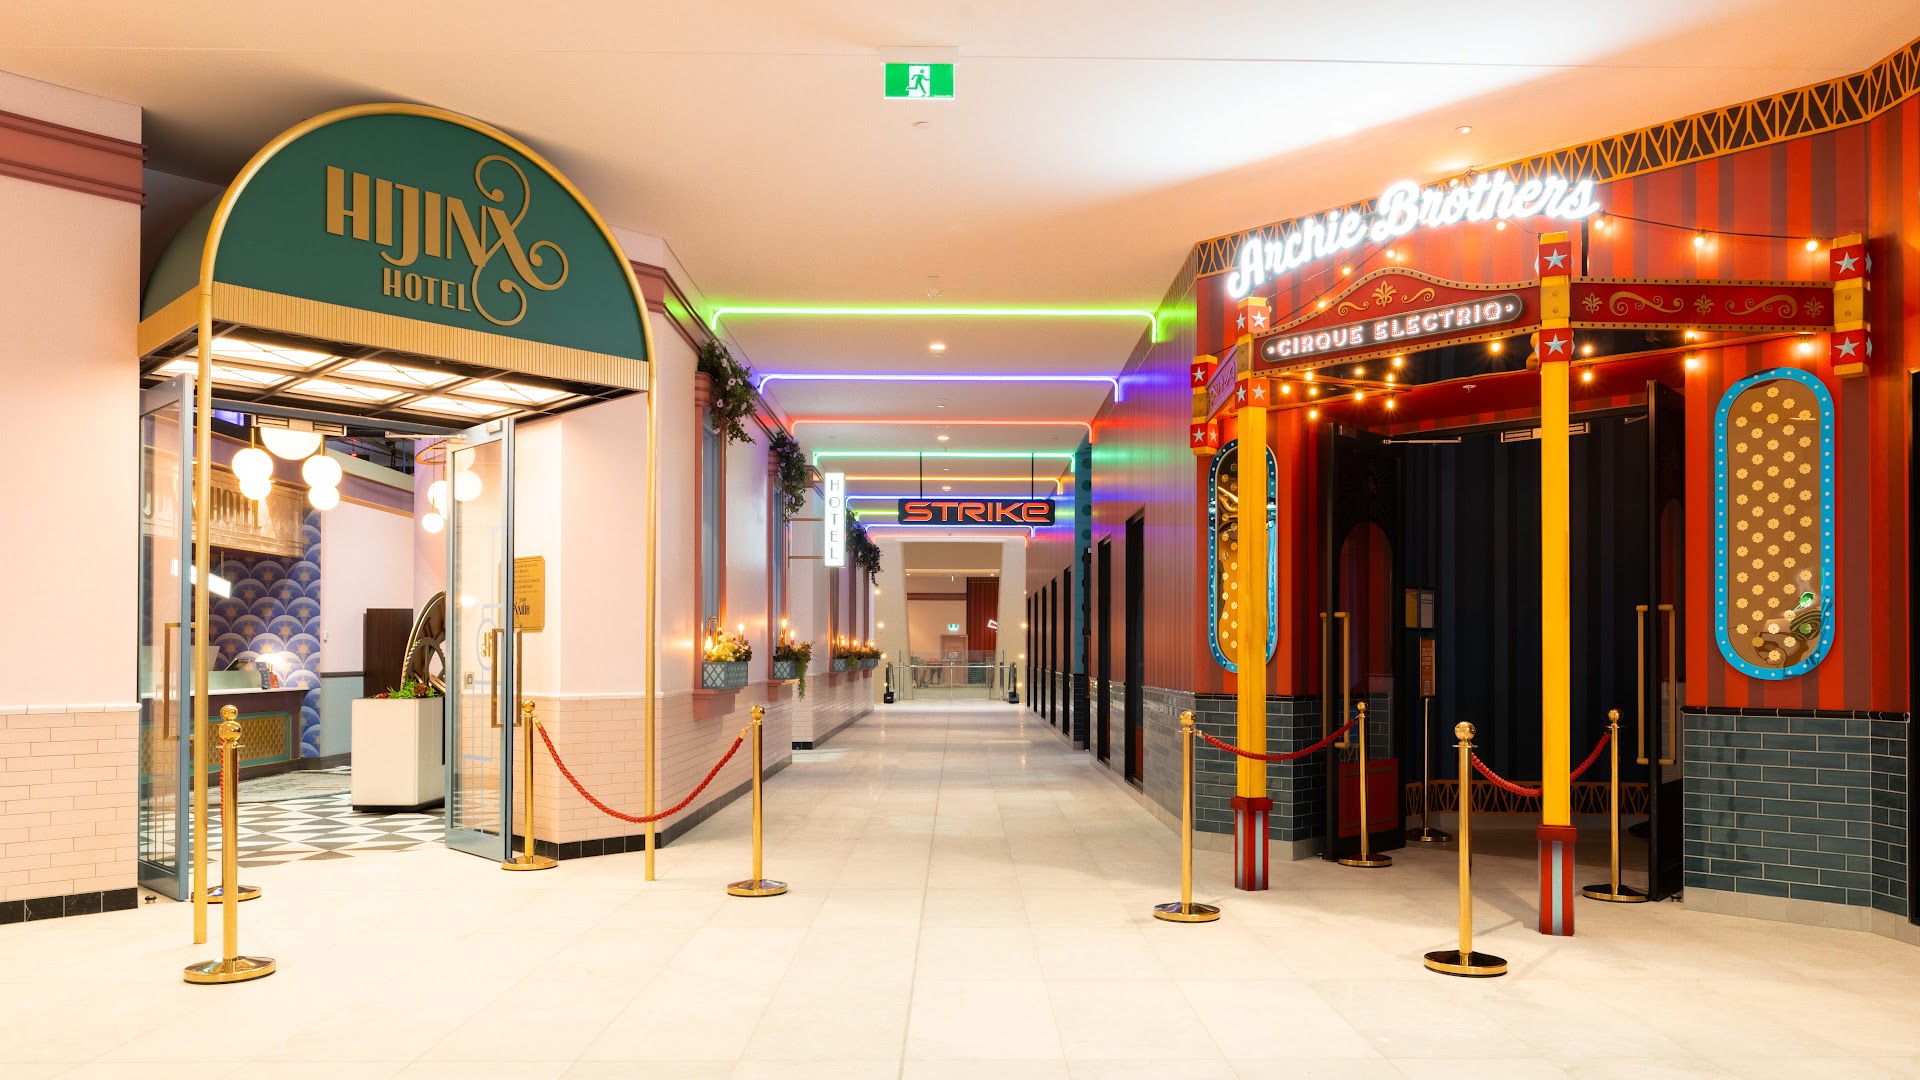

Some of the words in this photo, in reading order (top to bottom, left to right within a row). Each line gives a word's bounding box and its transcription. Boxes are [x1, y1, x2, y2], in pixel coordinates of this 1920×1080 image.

[326, 155, 569, 326] HIJINX
[1227, 210, 1367, 299] Archie
[1370, 171, 1602, 243] Brothers
[383, 267, 472, 312] HOTEL
[1275, 325, 1363, 357] CIRQUE
[1373, 301, 1501, 341] ELECTRIQ
[828, 479, 841, 560] HOTEL
[902, 501, 1051, 523] STRIKE
